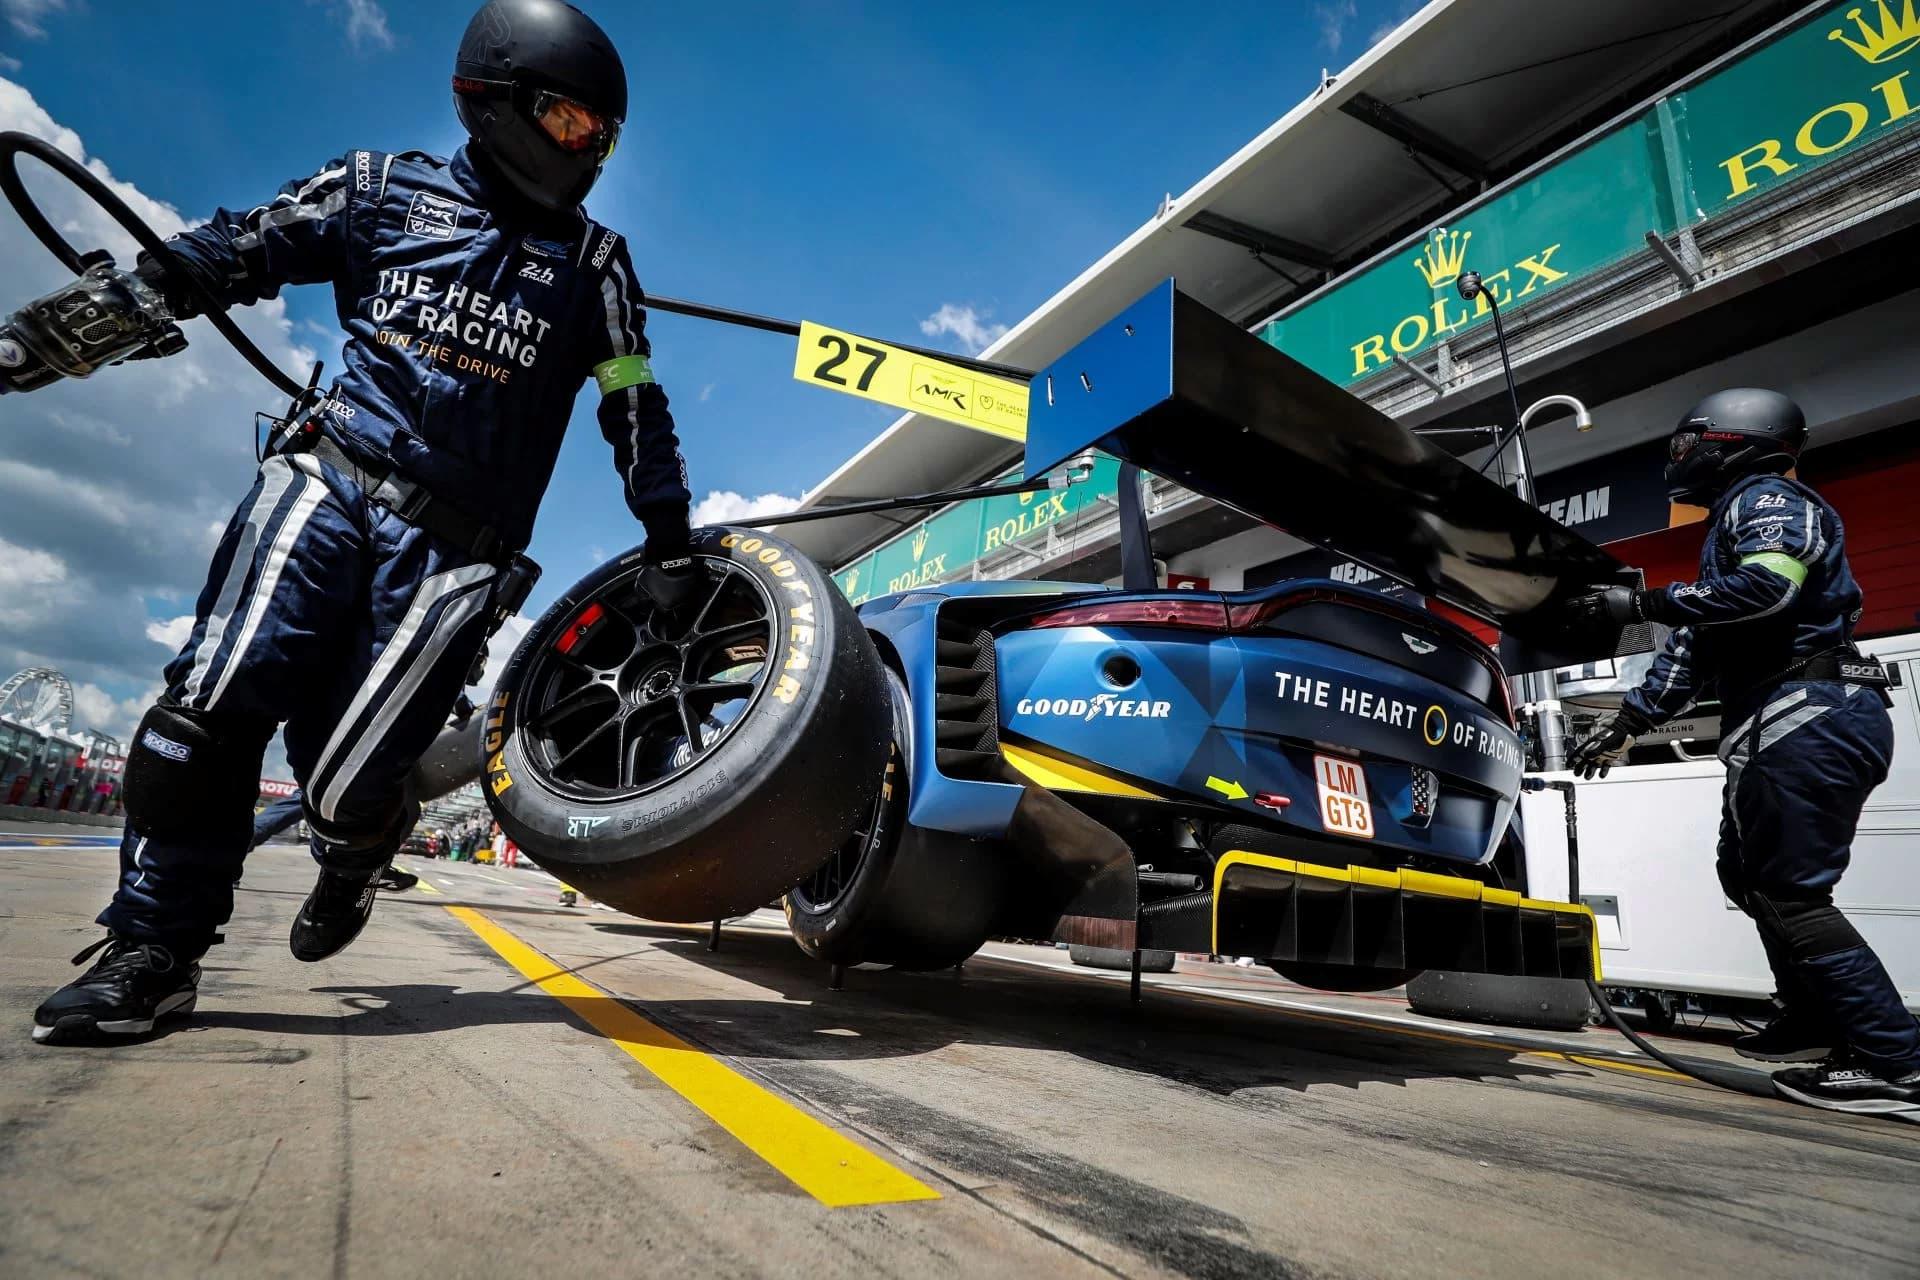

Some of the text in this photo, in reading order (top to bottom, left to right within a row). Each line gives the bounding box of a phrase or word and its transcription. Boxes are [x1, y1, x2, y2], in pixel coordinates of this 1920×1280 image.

[356, 150, 371, 192] sparco
[413, 204, 453, 226] AMR
[591, 230, 618, 270] sparco
[378, 269, 552, 343] THE HEART
[1350, 243, 1568, 377] ROLEX
[372, 298, 537, 368] OF RACING
[418, 339, 452, 363] THE
[457, 354, 511, 384] DRIVE
[813, 334, 888, 392] 27
[915, 383, 967, 411] AMR
[983, 491, 1070, 553] ROLEX
[889, 552, 947, 595] ROLEX
[720, 533, 816, 704] GOODYEAR
[1016, 695, 1171, 720] GOODYEAR
[1274, 671, 1520, 769] THE HEART OF RACING
[143, 733, 189, 757] sparco
[486, 690, 514, 798] EAGLE
[1323, 761, 1357, 796] LM
[1325, 793, 1368, 832] GT3
